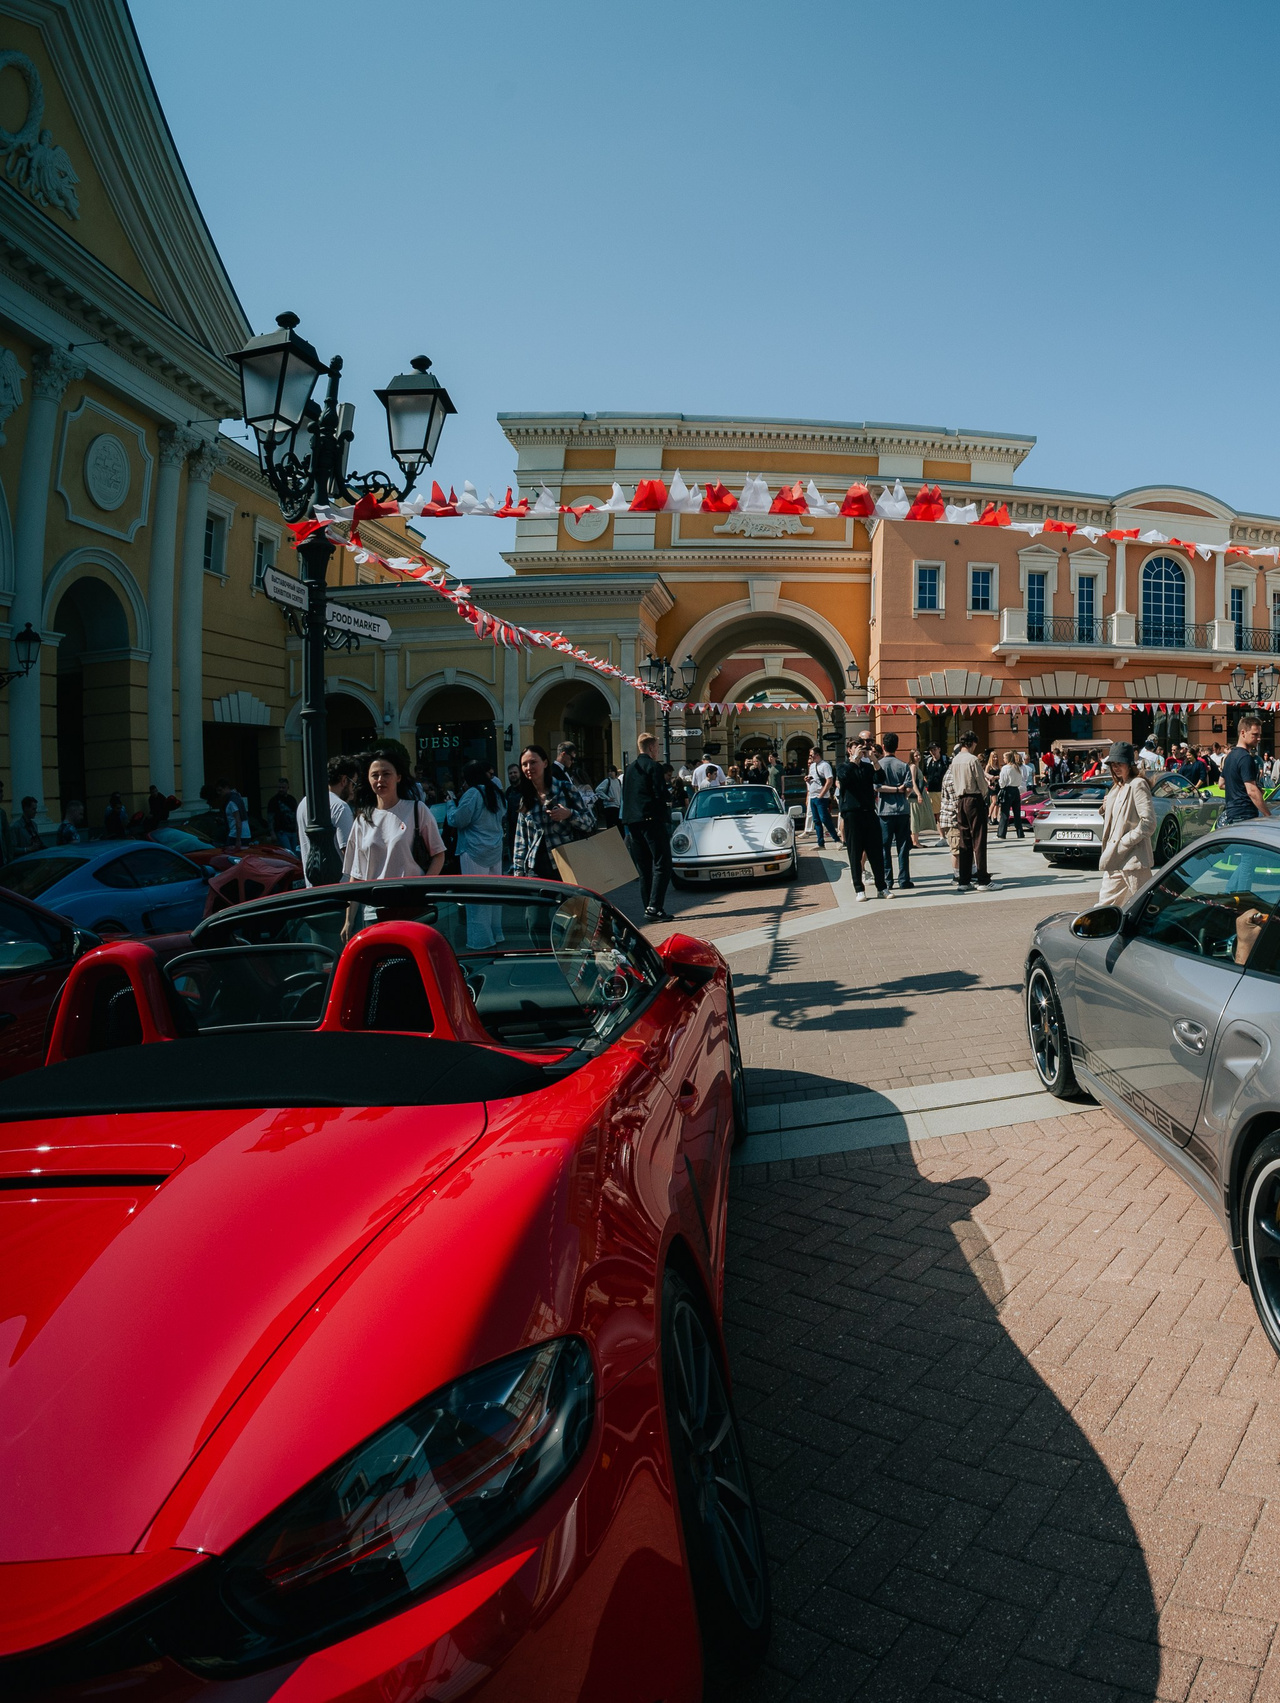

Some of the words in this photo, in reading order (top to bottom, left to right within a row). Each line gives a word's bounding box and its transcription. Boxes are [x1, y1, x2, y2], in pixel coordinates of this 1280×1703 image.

[273, 586, 291, 599] EXHIBITION
[332, 611, 352, 624] FOOD
[353, 617, 380, 633] MARKET
[1091, 1054, 1172, 1135] PORSCHE
